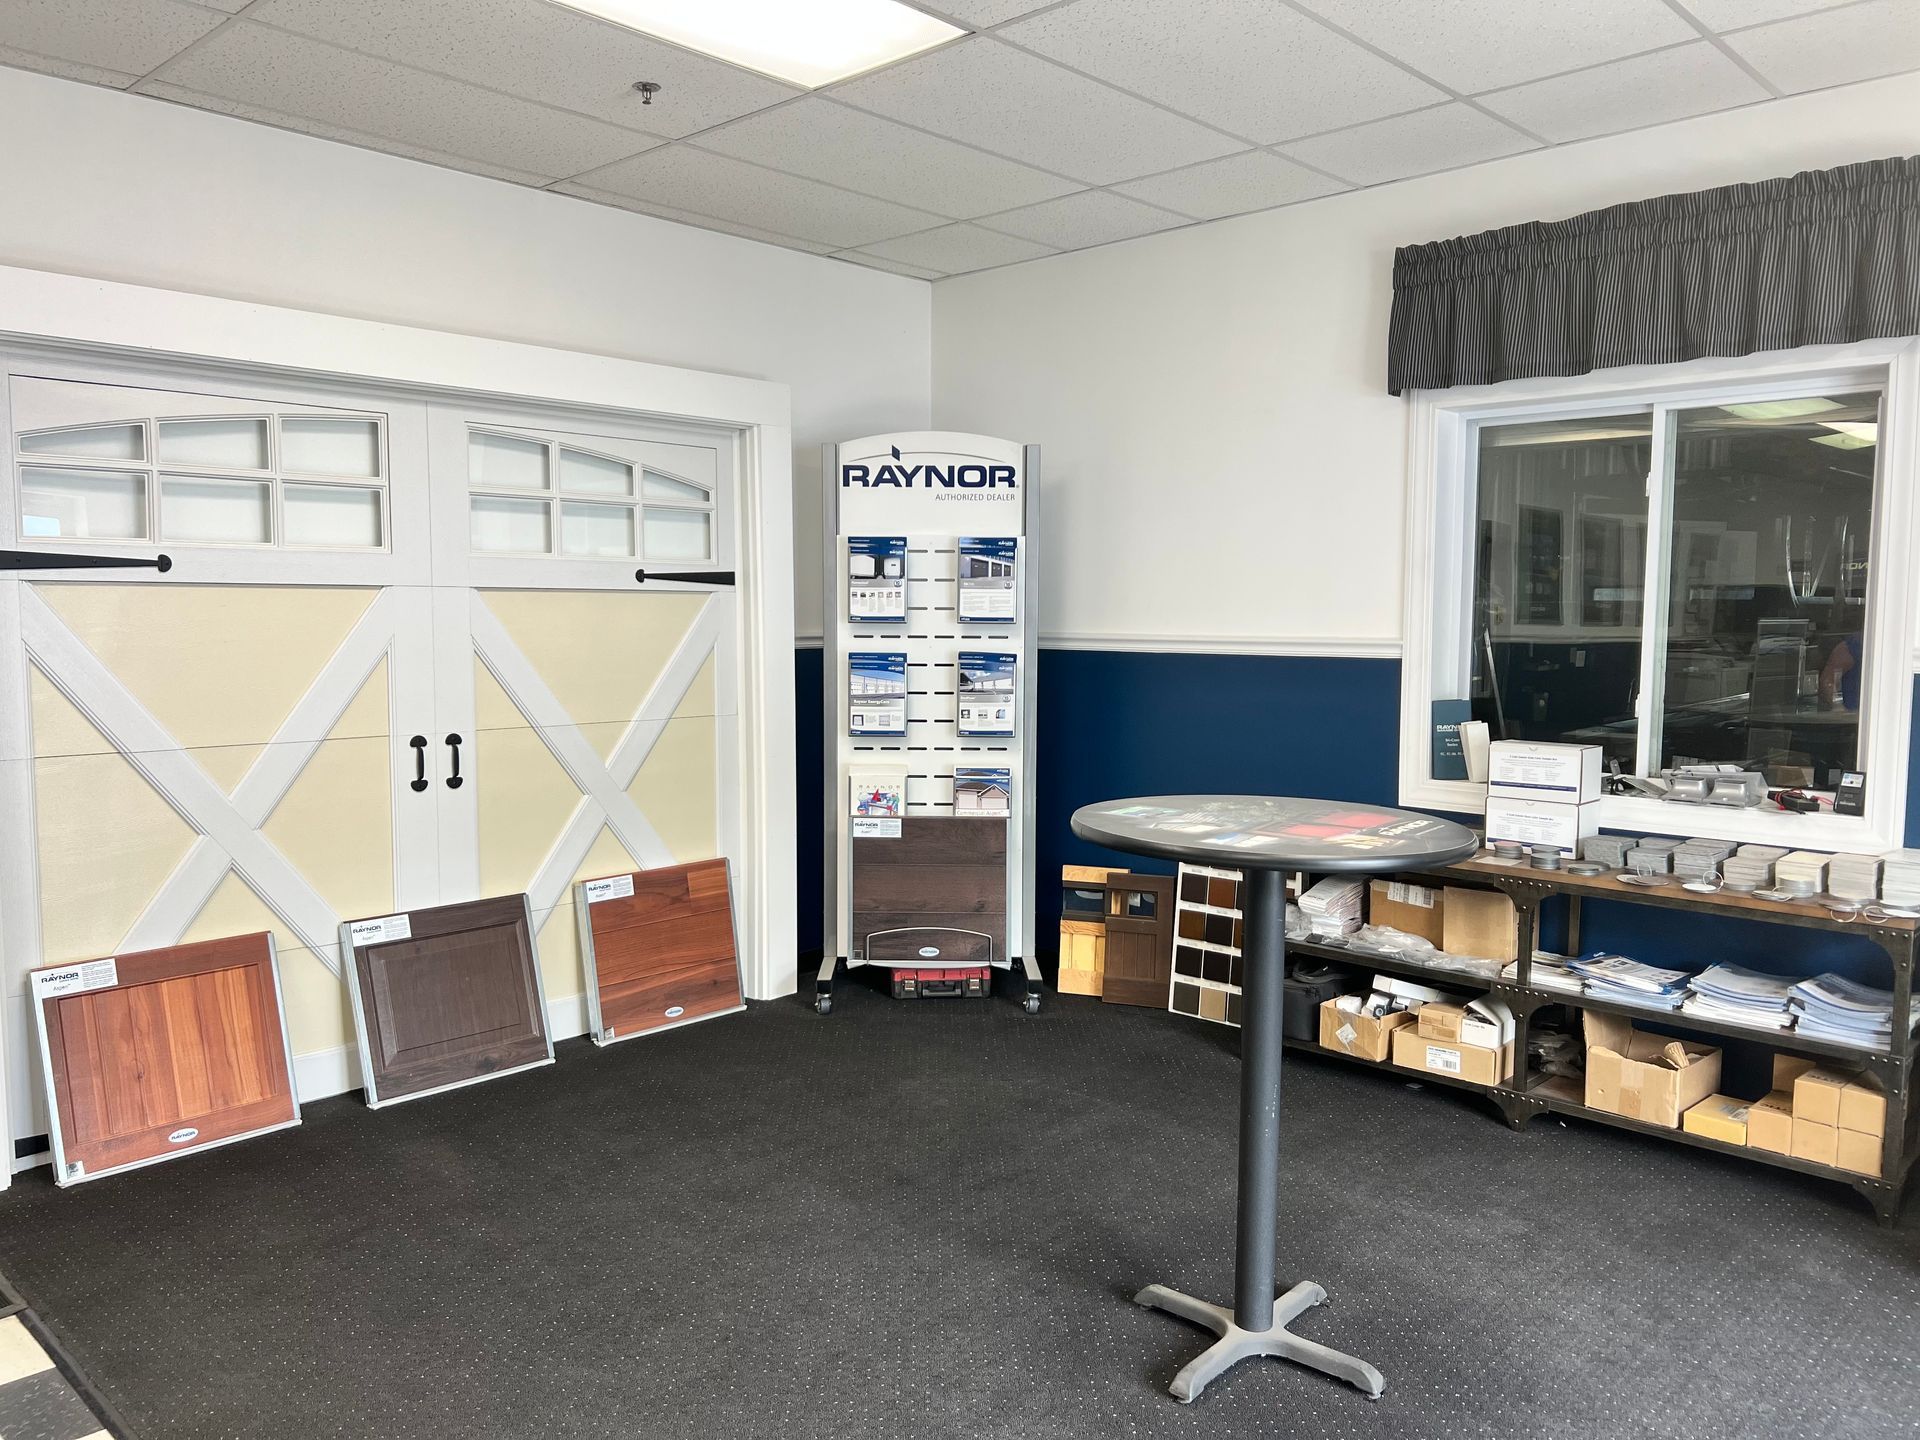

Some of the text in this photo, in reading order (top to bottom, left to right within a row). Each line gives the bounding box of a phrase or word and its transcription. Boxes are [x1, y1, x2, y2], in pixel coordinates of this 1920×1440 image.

[843, 465, 1016, 488] RAYNOR
[935, 493, 1016, 502] AUTHORIZED DEALER
[352, 924, 382, 934] RAYNOR
[41, 972, 79, 984] RAYNOR
